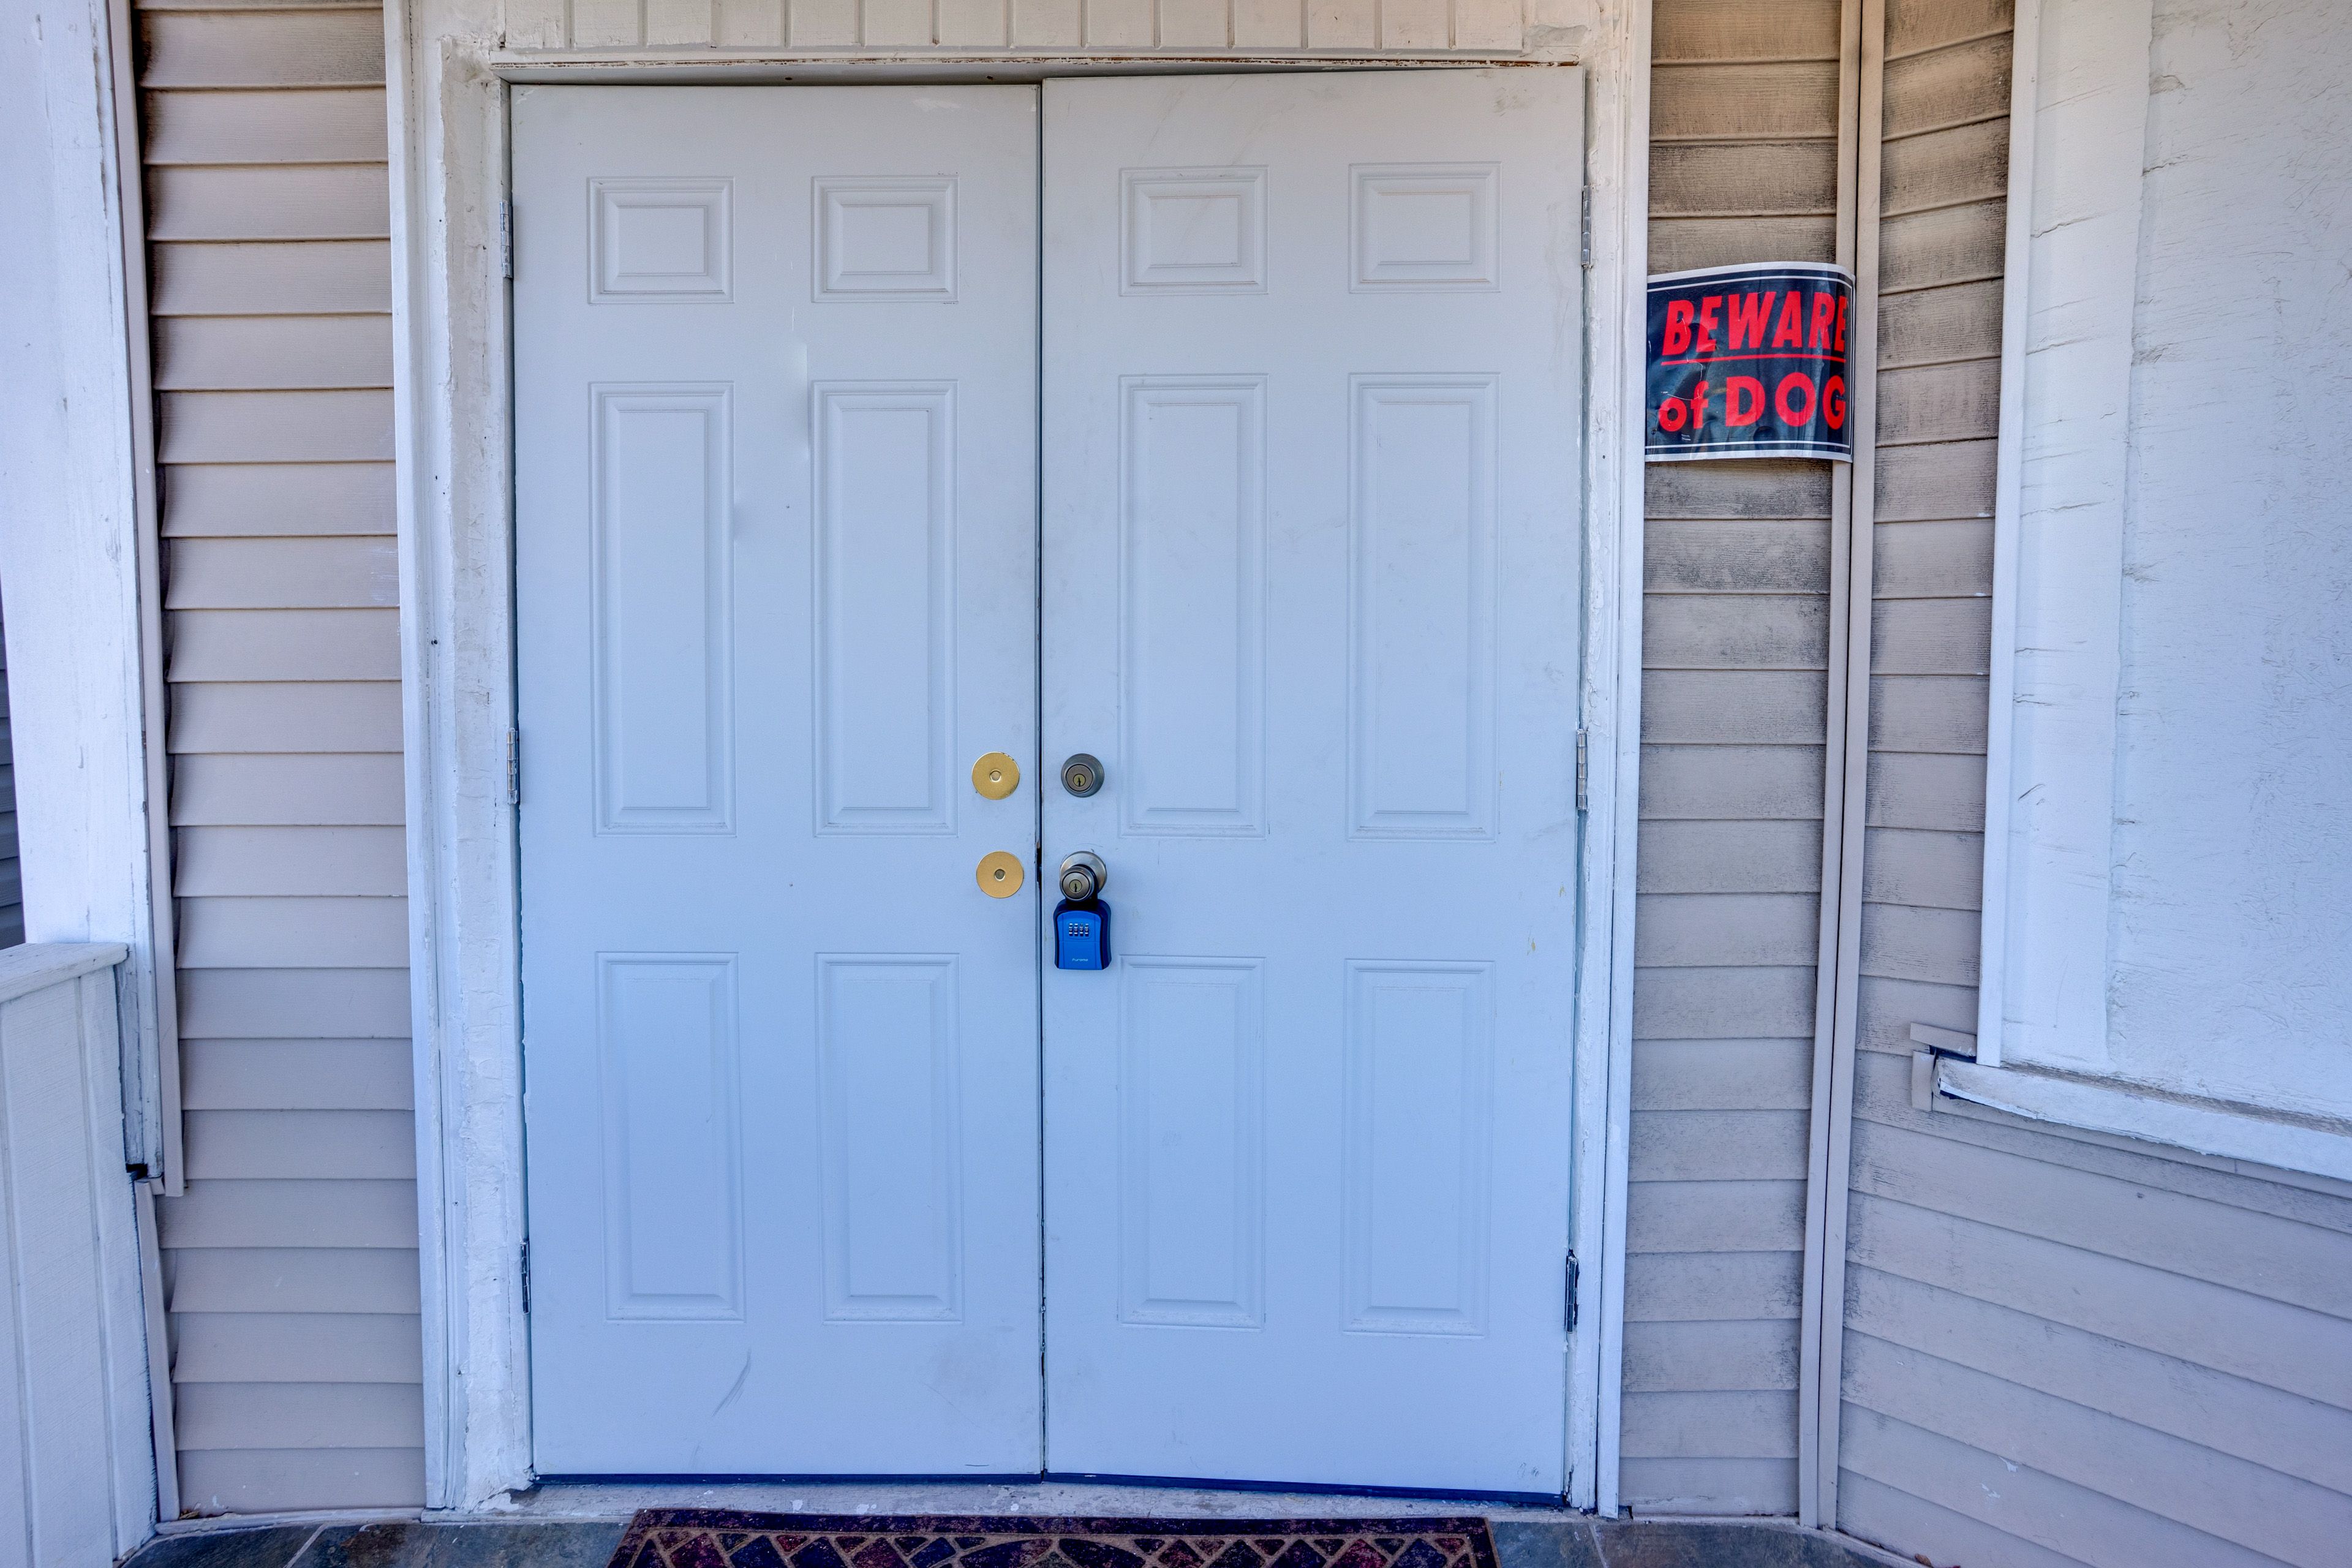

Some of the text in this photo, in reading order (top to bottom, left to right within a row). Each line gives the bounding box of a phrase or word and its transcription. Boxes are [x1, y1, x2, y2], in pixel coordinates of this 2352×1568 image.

[1662, 291, 1848, 356] BEWARE
[1658, 372, 1846, 432] of DOG
